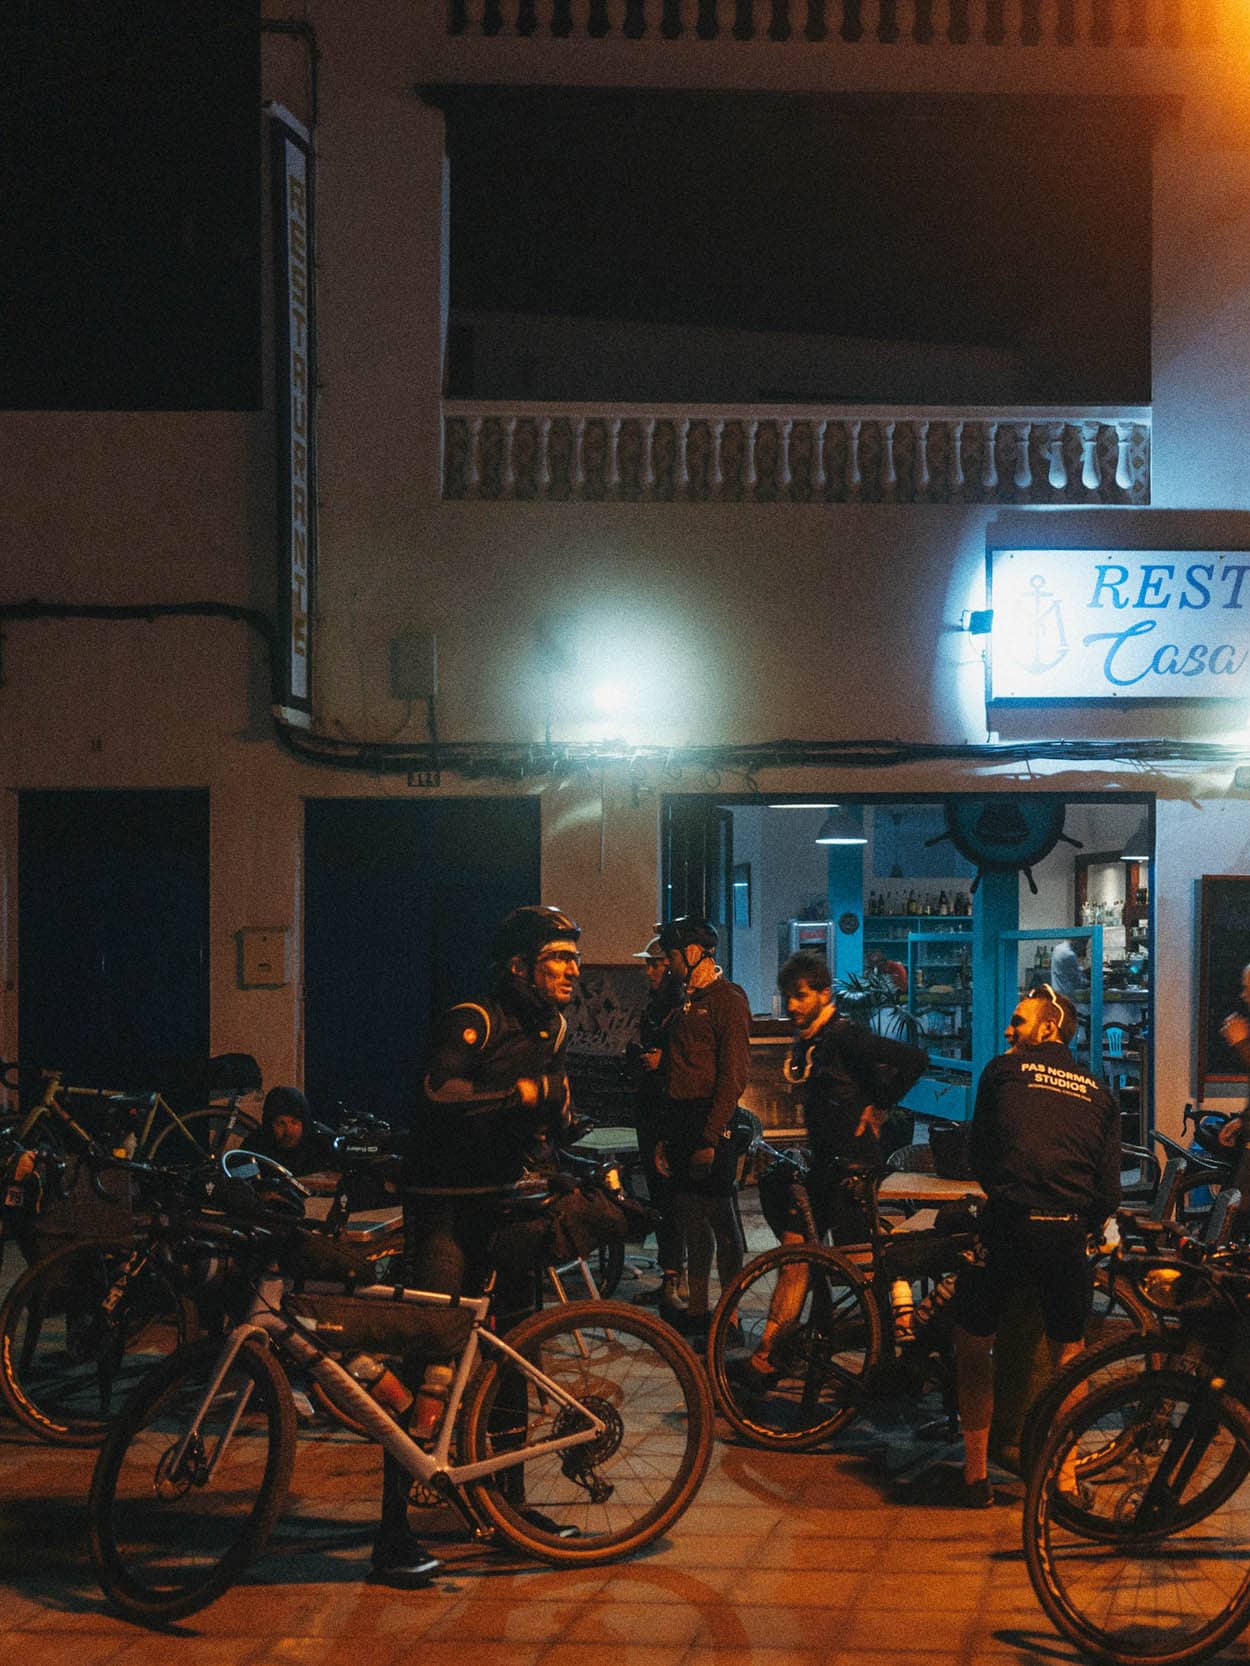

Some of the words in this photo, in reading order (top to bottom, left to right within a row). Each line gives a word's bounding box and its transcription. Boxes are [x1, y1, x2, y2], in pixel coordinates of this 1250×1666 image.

[287, 173, 307, 657] RESTAURANTE
[1083, 619, 1247, 686] Casa
[1021, 1063, 1046, 1072] PAS
[1047, 1066, 1099, 1090] NORMAL
[1034, 1073, 1087, 1094] STUDIOS
